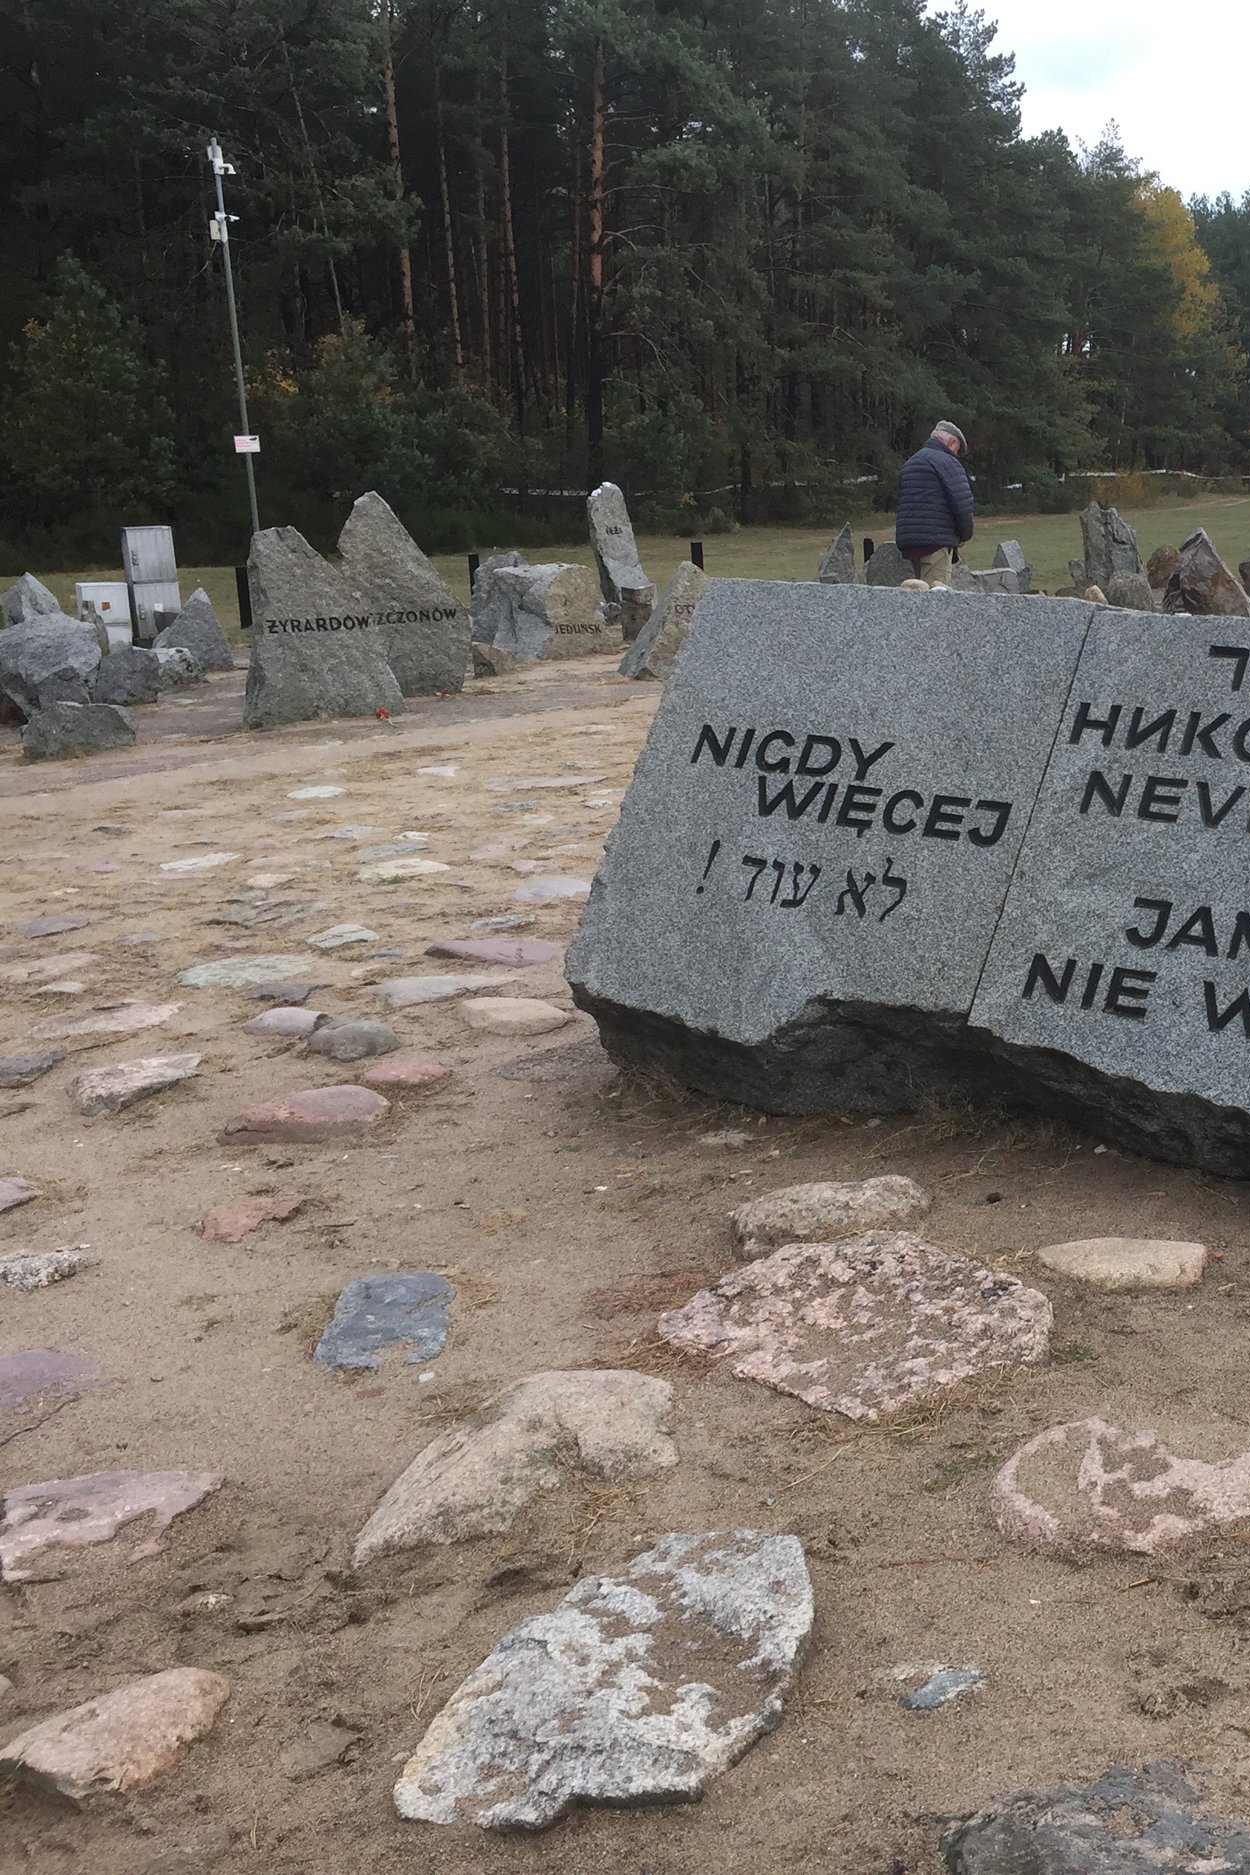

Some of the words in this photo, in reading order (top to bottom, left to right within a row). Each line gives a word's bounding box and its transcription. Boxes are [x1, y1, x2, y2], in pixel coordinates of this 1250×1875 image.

[265, 614, 370, 634] ŻYRARDÓW
[369, 607, 457, 626] ZCZONÓW
[690, 724, 895, 782] NIGDY
[757, 775, 1013, 848] WIĘCEJ
[742, 854, 823, 908] עוד
[833, 856, 908, 923] לא
[1021, 952, 1158, 1021] NIE
